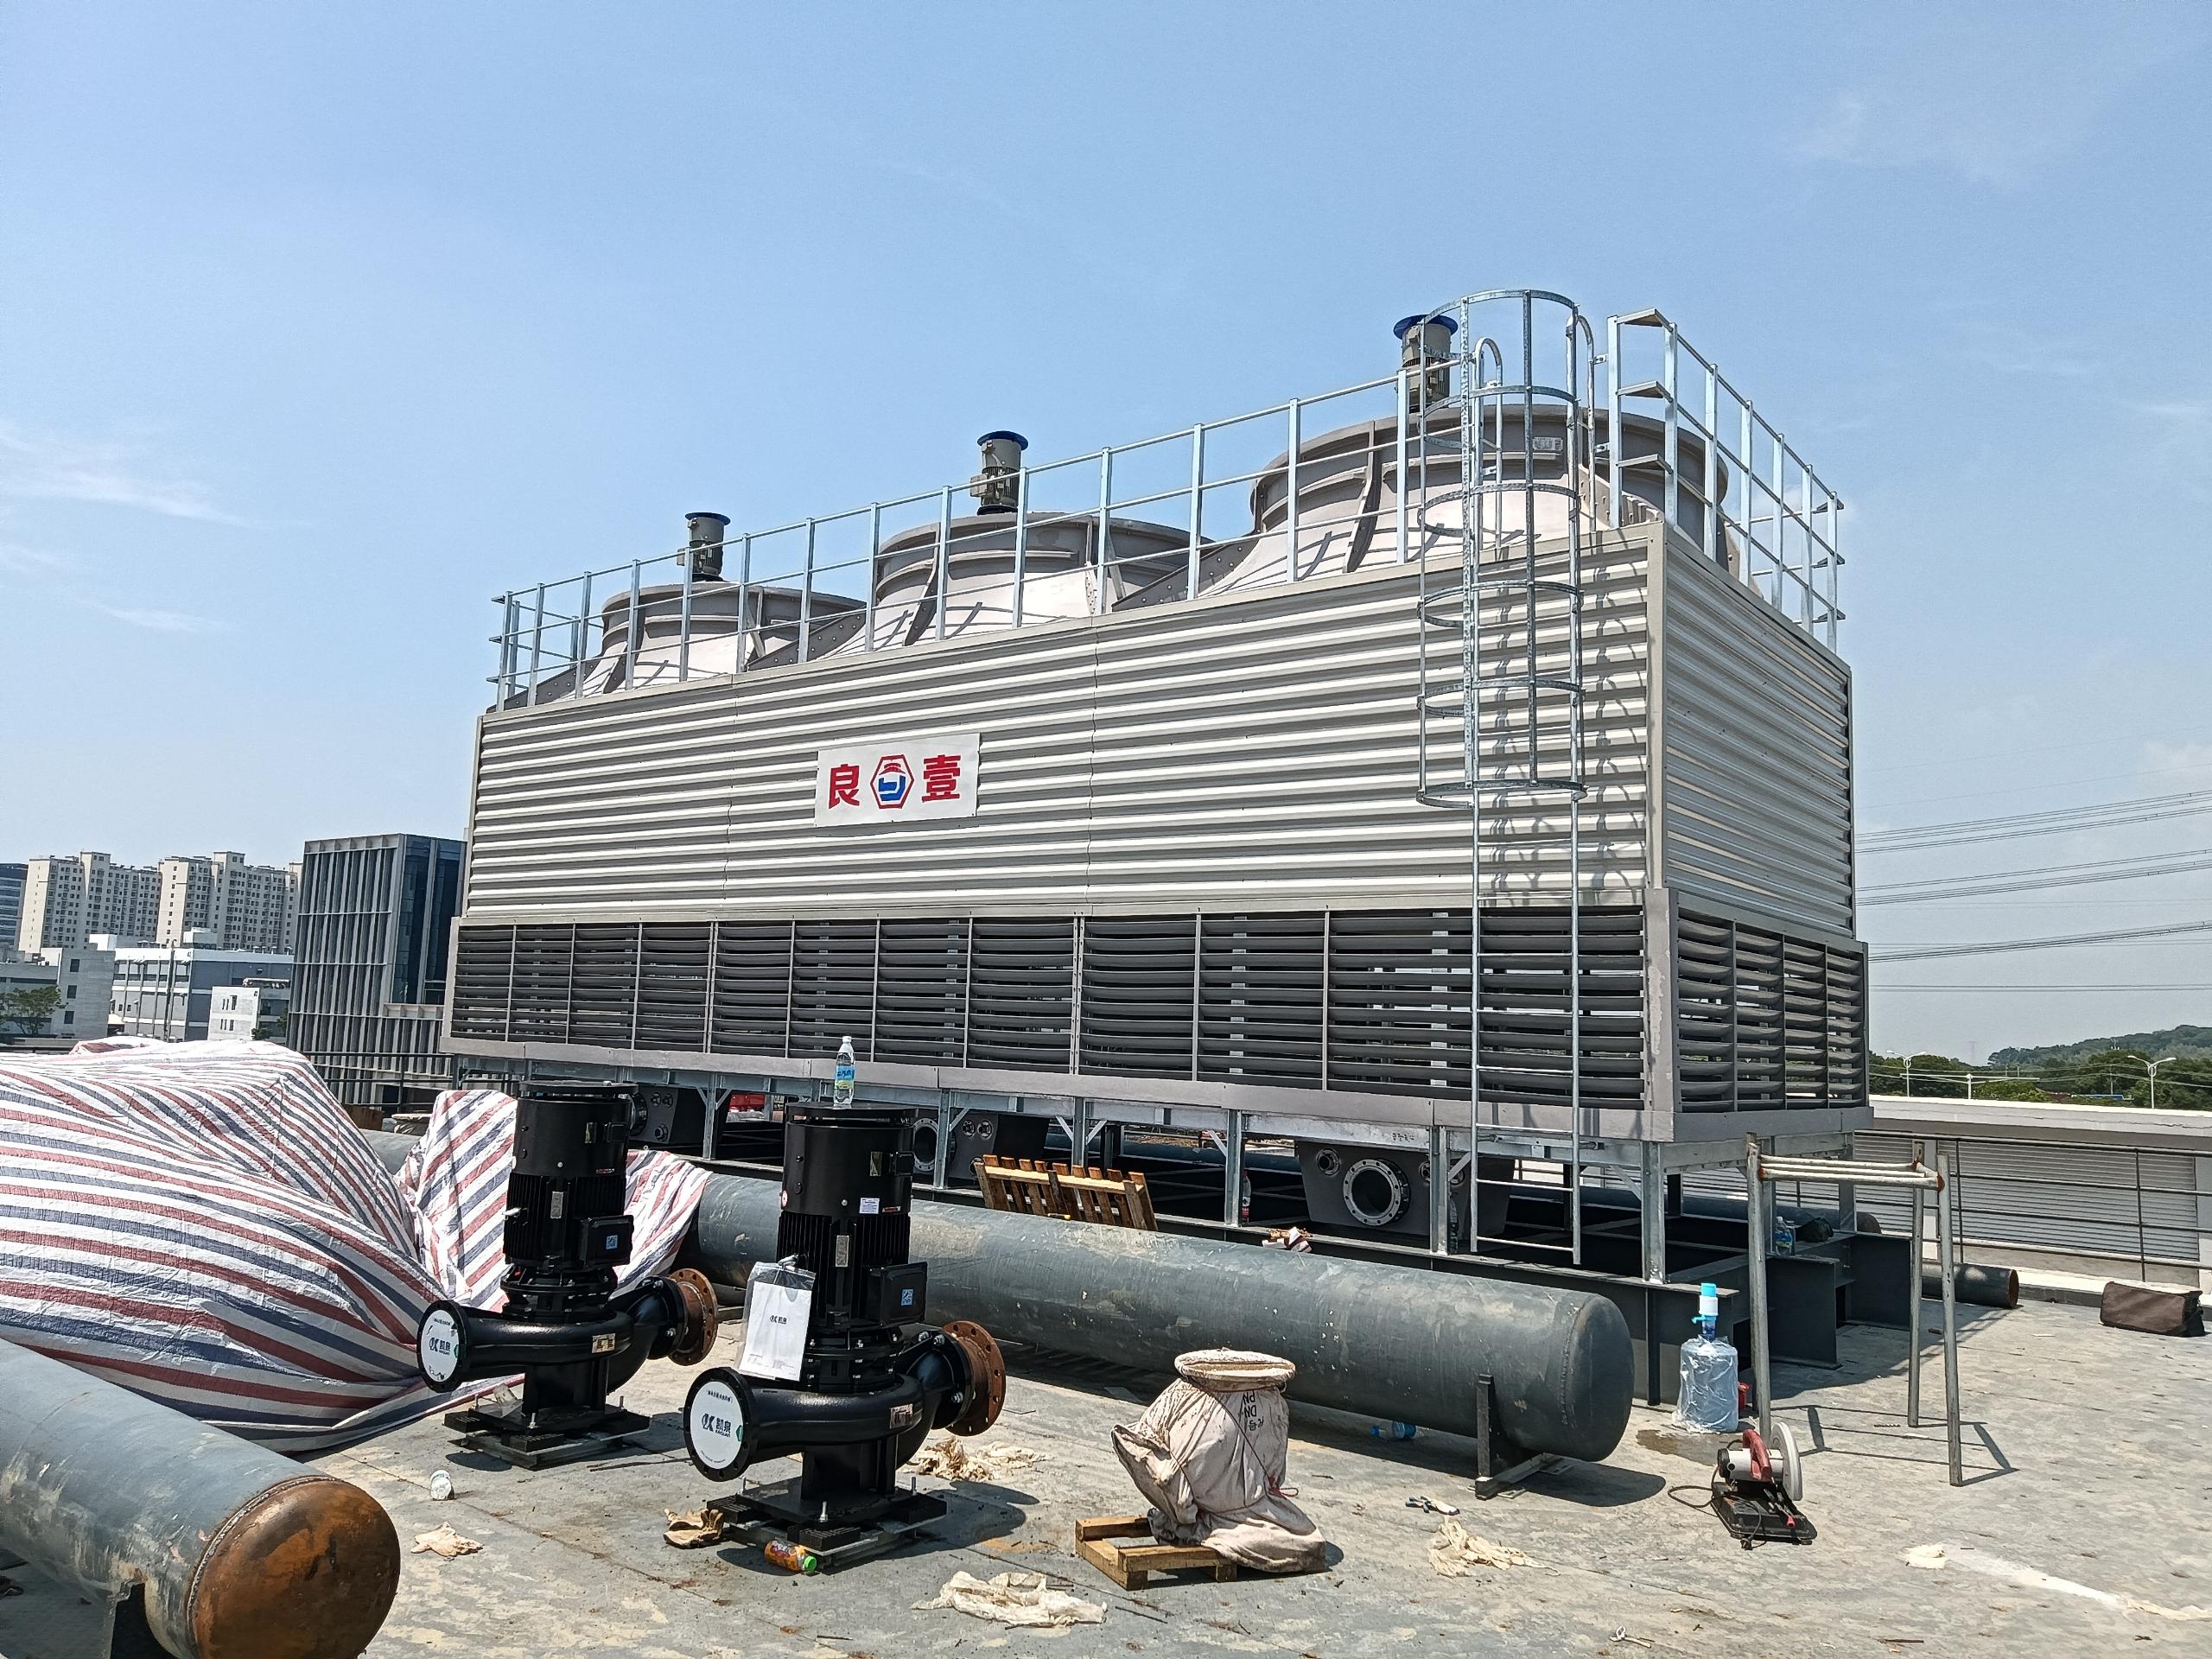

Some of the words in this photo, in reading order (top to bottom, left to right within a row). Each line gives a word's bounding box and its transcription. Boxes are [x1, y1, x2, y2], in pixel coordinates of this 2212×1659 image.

[829, 764, 860, 809] 良
[922, 754, 961, 803] 壹
[1244, 1404, 1257, 1418] DN
